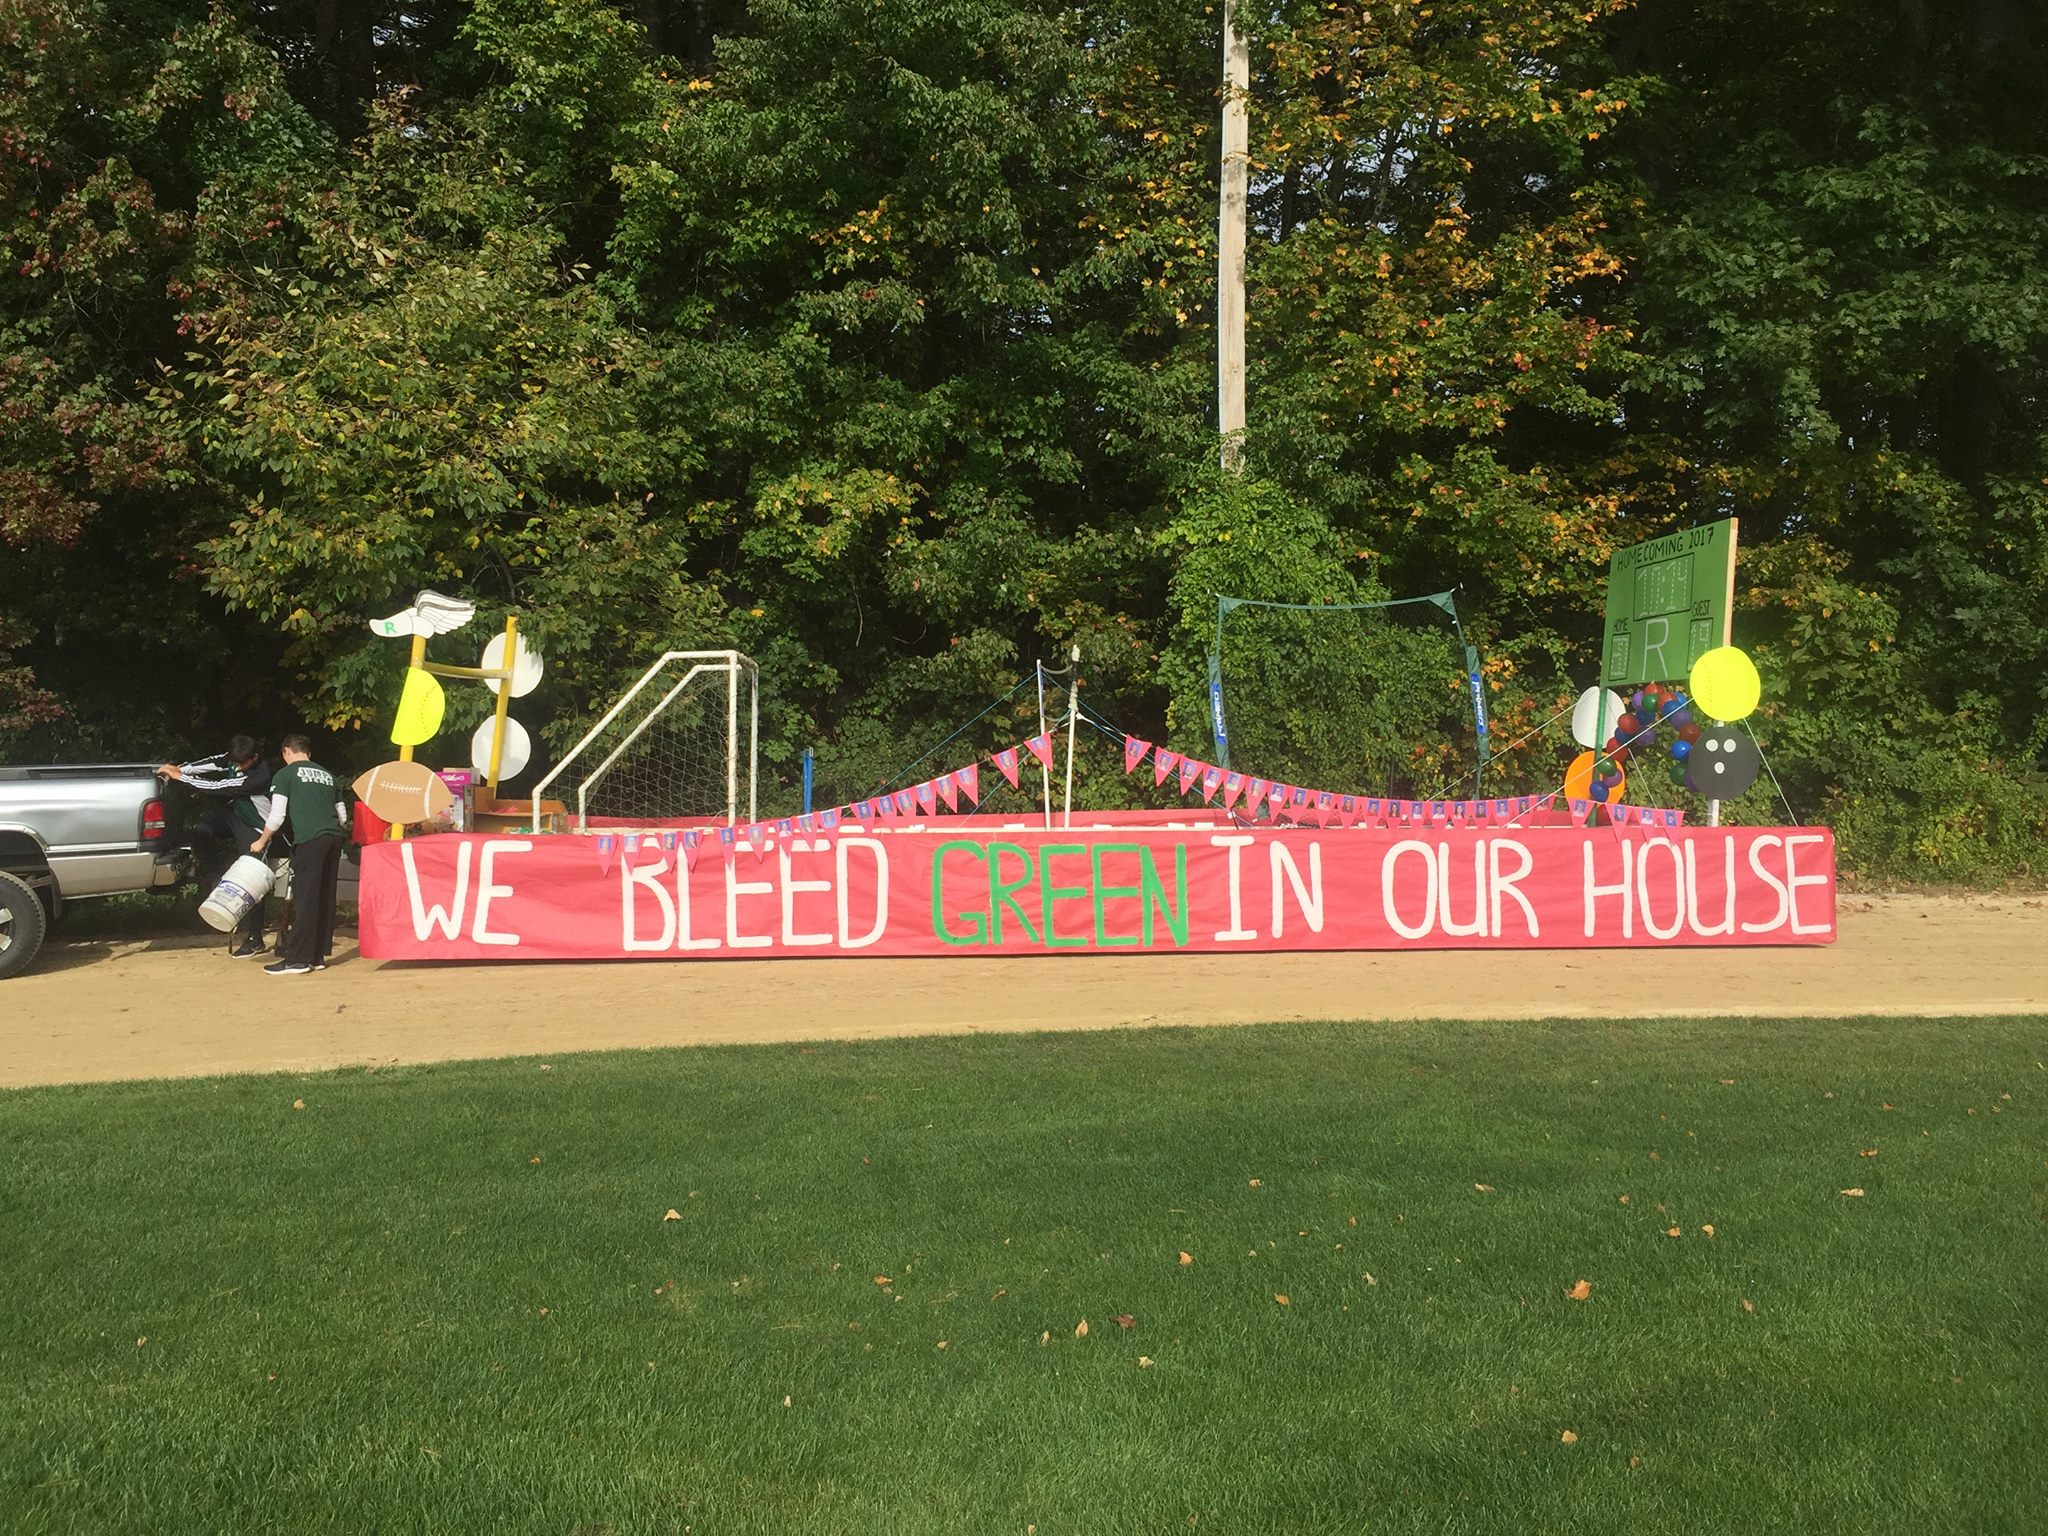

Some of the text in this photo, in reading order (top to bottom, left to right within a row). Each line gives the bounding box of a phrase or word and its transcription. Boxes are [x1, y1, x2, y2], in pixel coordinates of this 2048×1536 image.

[1617, 526, 1714, 572] HOMECOMING 2017
[384, 621, 397, 635] R
[1612, 617, 1629, 633] HOME
[1641, 618, 1669, 681] R
[401, 835, 1832, 951] WE BLEED GREEN IN OUR HOUSE
